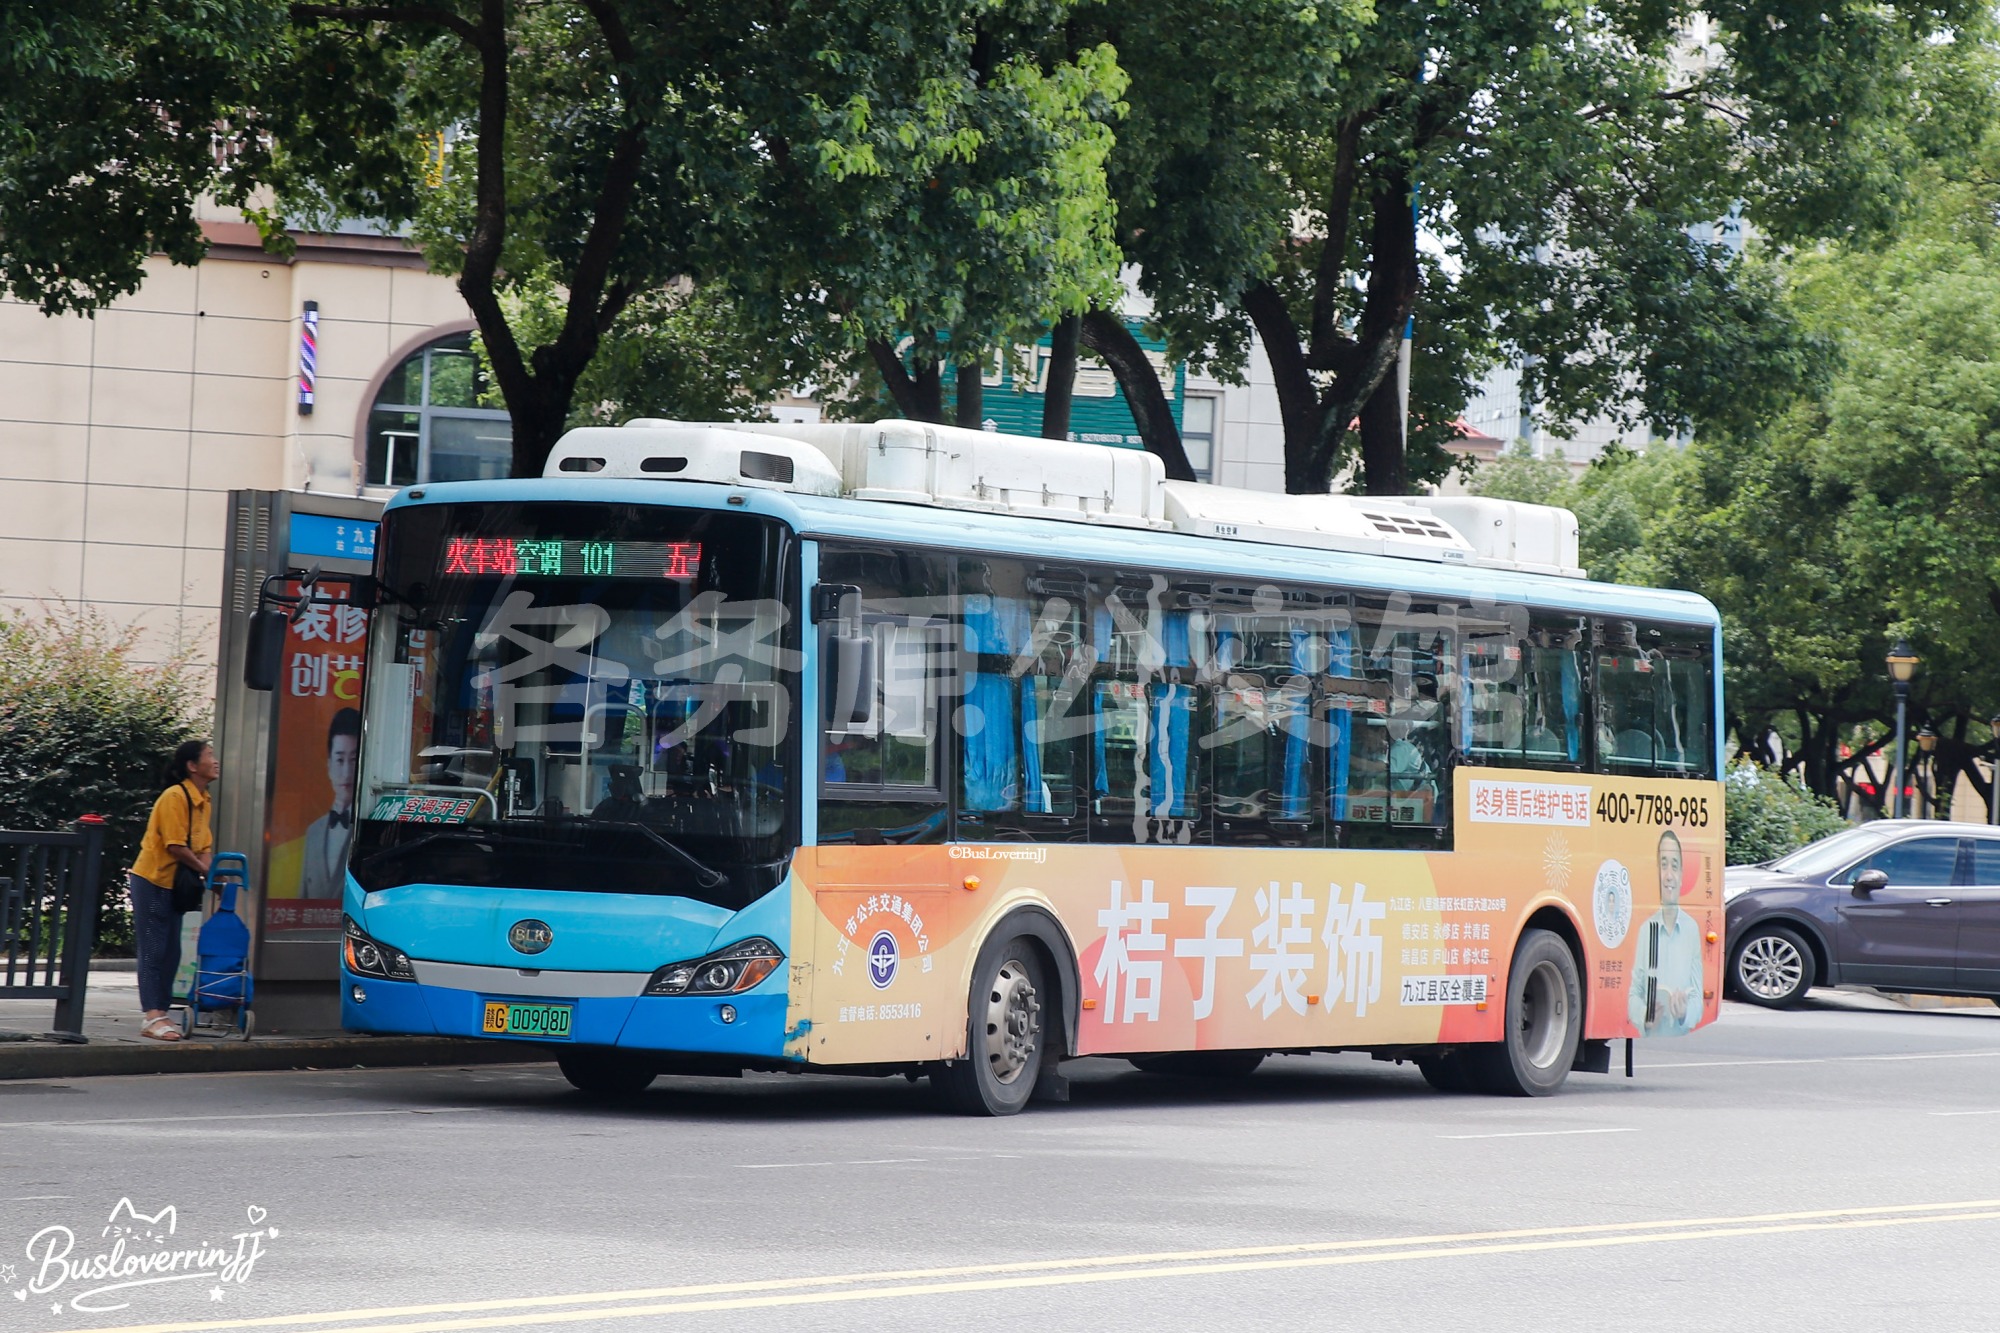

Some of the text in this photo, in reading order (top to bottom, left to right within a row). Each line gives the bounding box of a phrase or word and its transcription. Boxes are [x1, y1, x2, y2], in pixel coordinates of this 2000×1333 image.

[580, 542, 613, 575] 101
[664, 542, 701, 576] 五
[401, 797, 471, 817] 空调开启
[1475, 786, 1708, 828] 终身售后维护电话 400-7788-985
[832, 893, 933, 977] 九江市公共交通集团公司
[1463, 923, 1490, 940] 共青店
[1094, 880, 1386, 1024] 桔子装饰
[1462, 948, 1490, 965] 修水店
[1402, 979, 1485, 1003] 九江县区全覆盖
